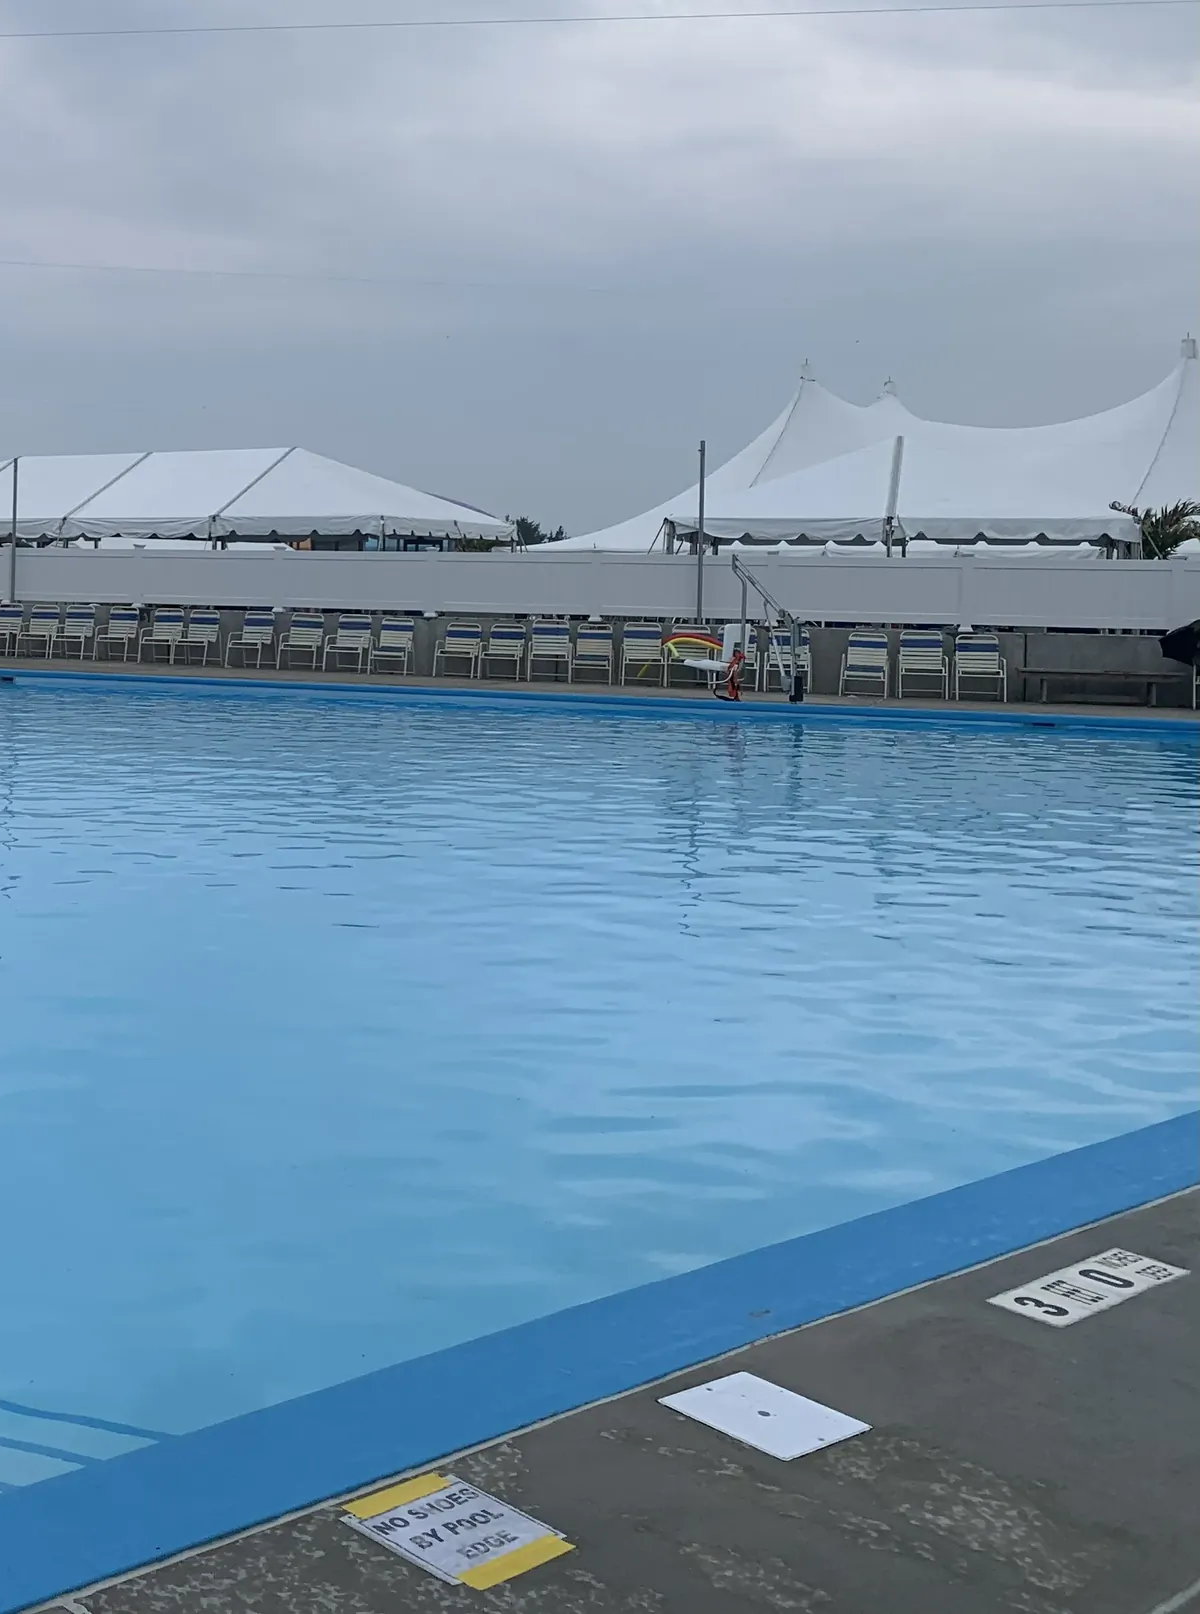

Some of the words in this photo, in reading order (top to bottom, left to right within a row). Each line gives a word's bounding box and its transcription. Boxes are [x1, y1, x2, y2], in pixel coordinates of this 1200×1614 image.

[1040, 1279, 1109, 1306] FEET
[1078, 1268, 1135, 1289] 0
[1013, 1296, 1069, 1317] 3
[372, 1515, 410, 1537] NO
[413, 1487, 481, 1521] SHOES
[409, 1528, 444, 1550] BY
[441, 1508, 505, 1535] POOL
[456, 1529, 520, 1560] EDGE
